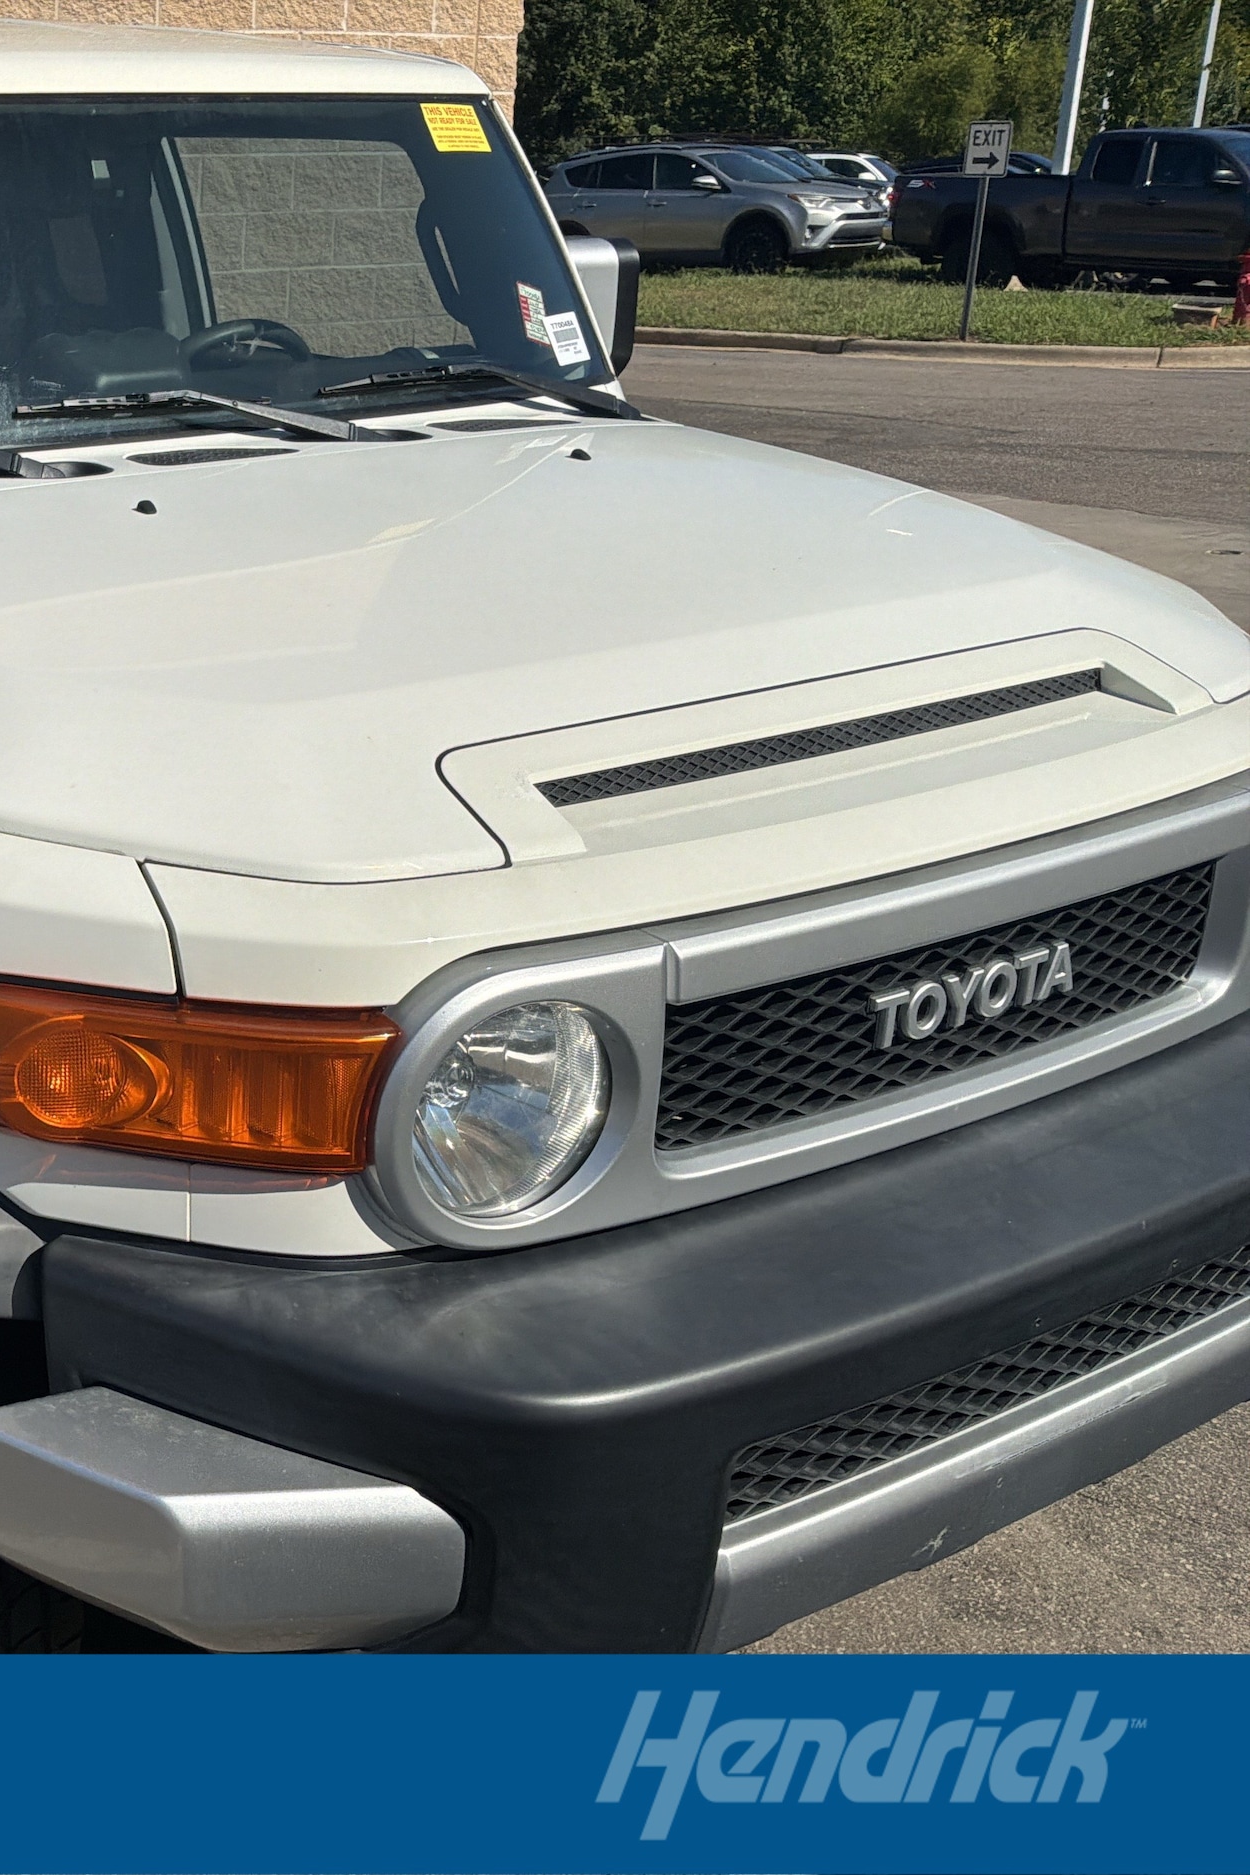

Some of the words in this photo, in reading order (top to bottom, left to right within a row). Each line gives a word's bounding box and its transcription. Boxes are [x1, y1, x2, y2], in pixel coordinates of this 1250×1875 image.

[424, 107, 443, 116] THIS
[443, 107, 474, 117] VEHICLE
[973, 130, 1006, 146] EXIT
[869, 940, 1073, 1050] TOYOTA
